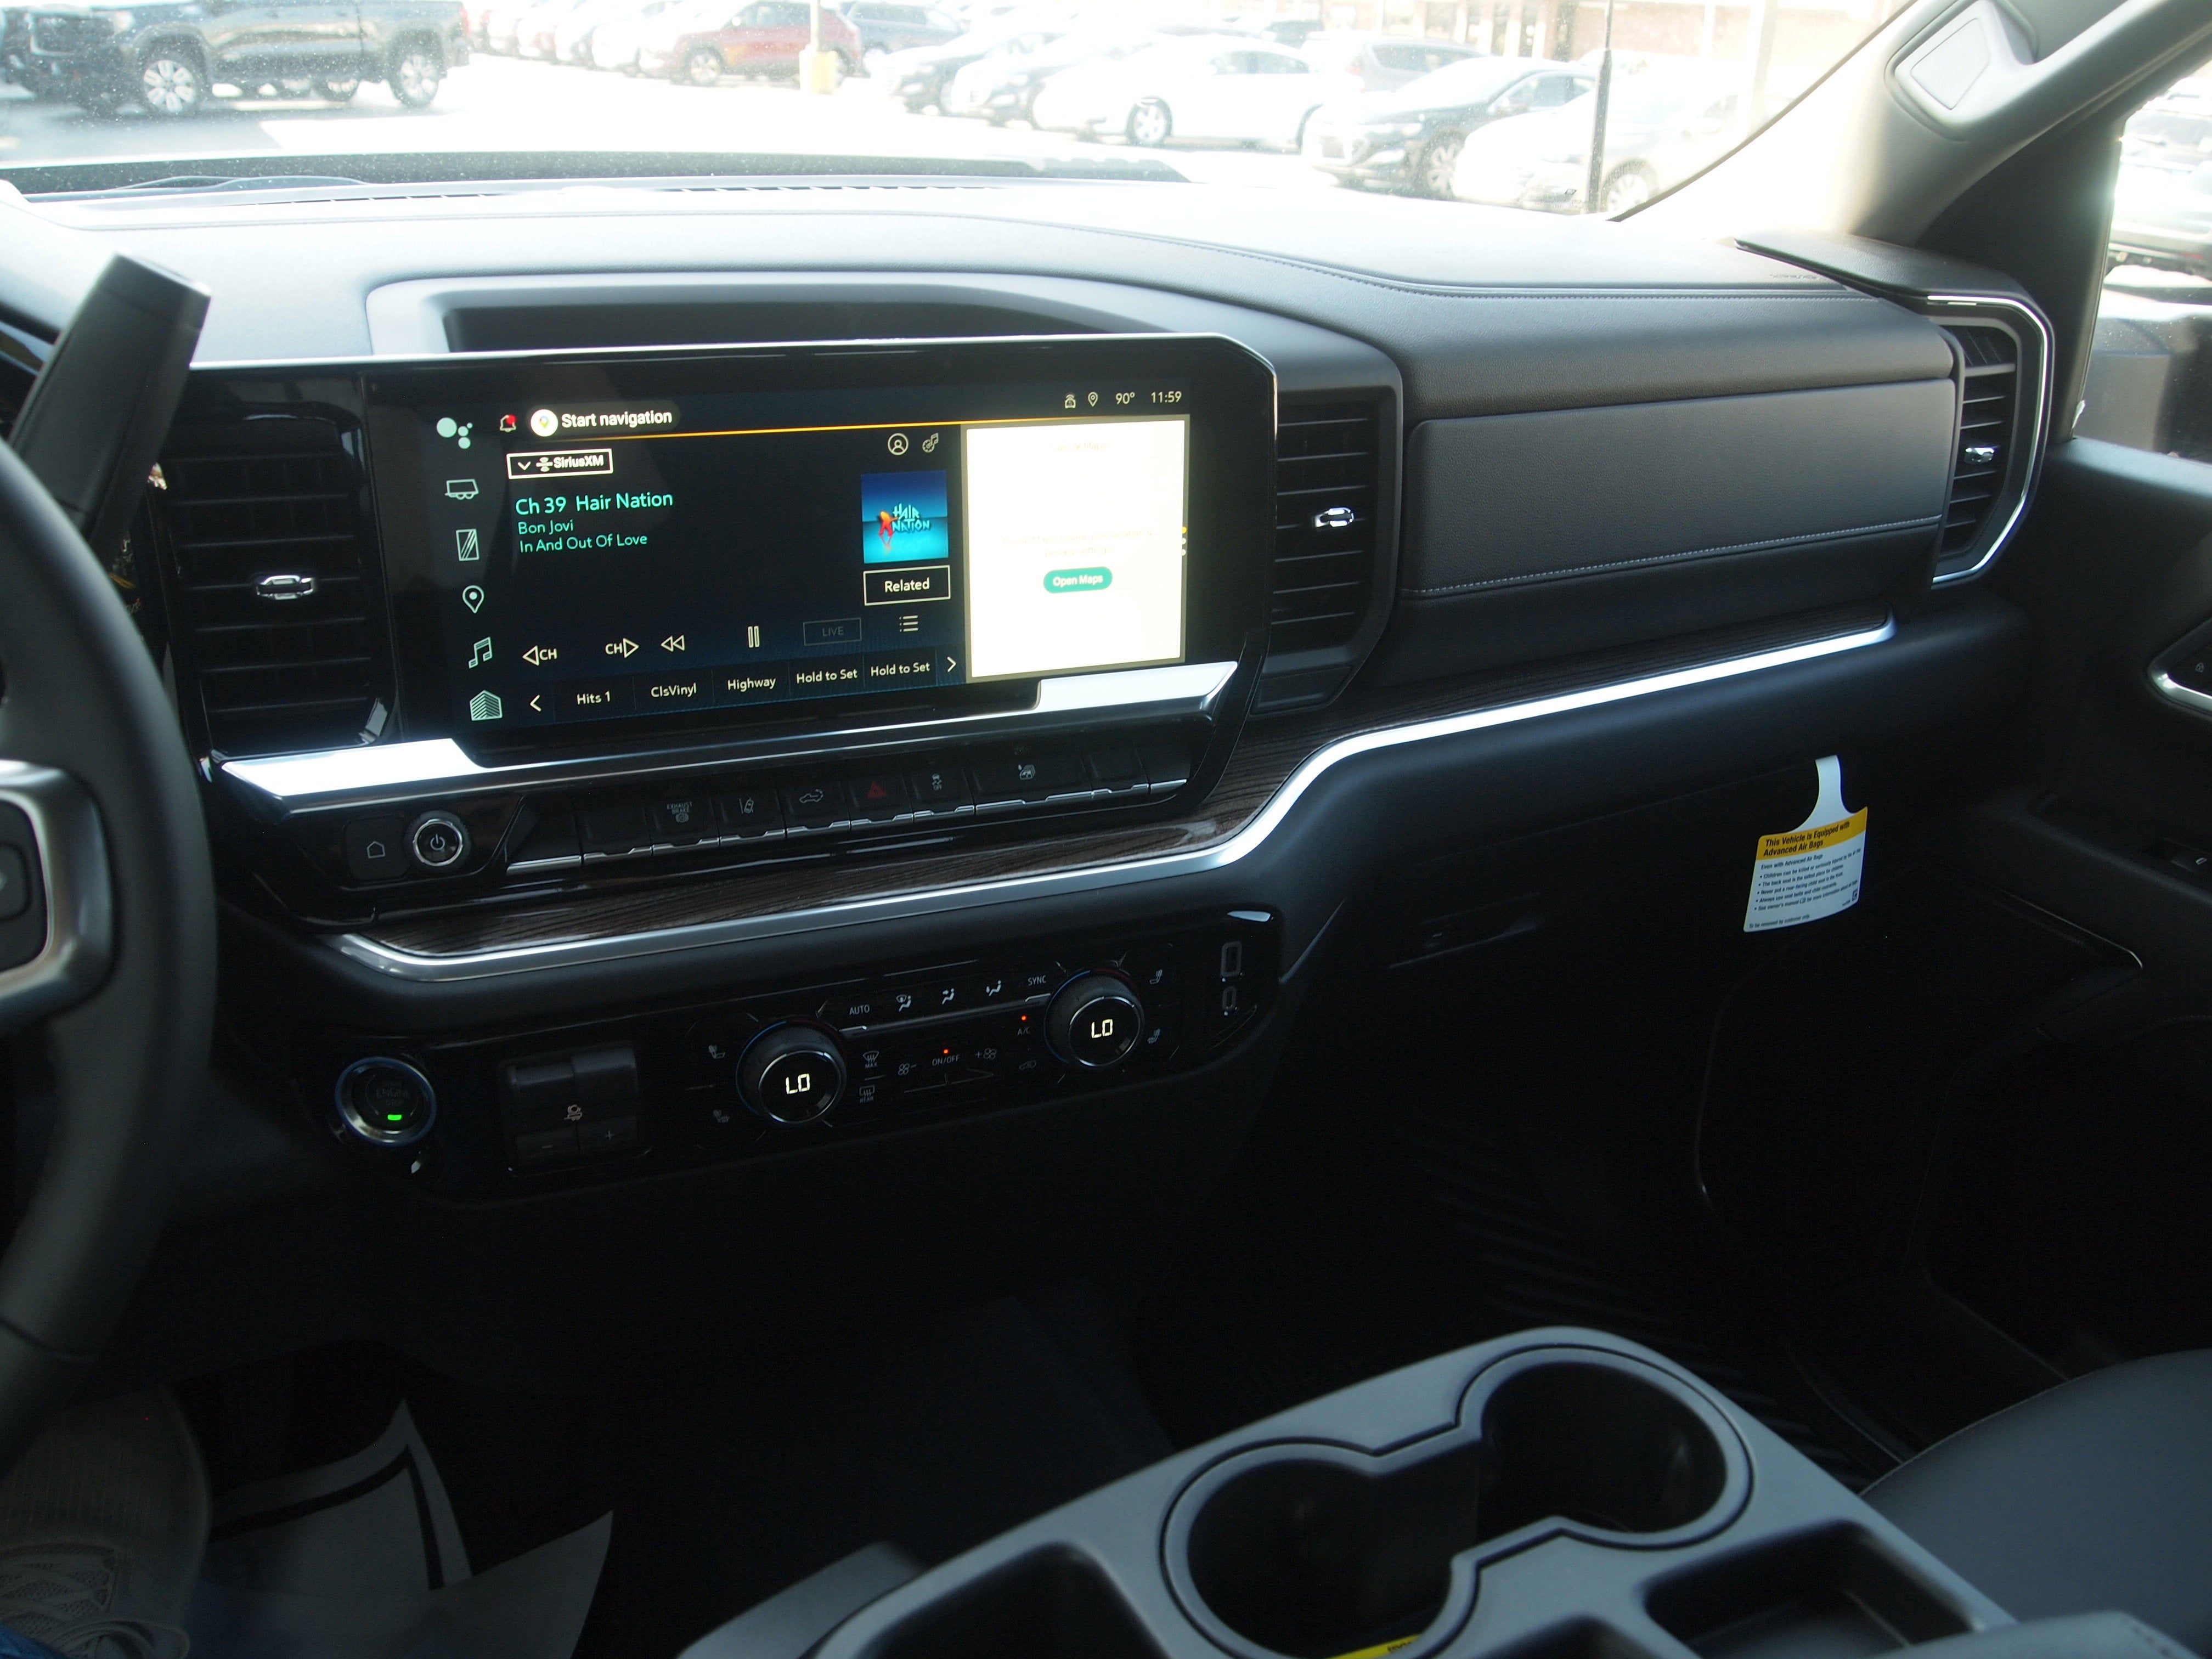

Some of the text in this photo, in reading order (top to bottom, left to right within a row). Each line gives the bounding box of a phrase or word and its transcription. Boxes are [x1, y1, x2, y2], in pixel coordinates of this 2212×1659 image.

[1151, 391, 1182, 403] 11:59
[561, 410, 672, 428] Start navigation
[553, 455, 604, 469] SiriusXM
[516, 492, 673, 515] Ch 39 Hair Nation
[518, 519, 574, 535] Bon Jovi
[520, 533, 647, 553] In And Out Of Love
[884, 577, 930, 592] Related
[1053, 574, 1103, 588] Open Maps
[822, 626, 844, 637] LIVE
[539, 648, 557, 661] CH
[605, 642, 623, 655] CH
[796, 669, 857, 684] Hold to Set
[871, 662, 930, 678] Hold to Set
[651, 682, 697, 698] ClsVinyl
[727, 676, 776, 692] Highway
[577, 691, 611, 706] Hits 1
[1765, 838, 1780, 847] This
[1782, 834, 1805, 844] Vehicle
[1814, 824, 1839, 839] Equipped
[1839, 821, 1850, 830] with
[1763, 840, 1823, 857] Advanced Air Bags
[1784, 857, 1806, 866] Advanced
[1027, 975, 1047, 986] SYNC
[849, 1005, 870, 1015] AUTO
[1018, 1028, 1031, 1036] A/C
[932, 1054, 960, 1066] ON/OFF
